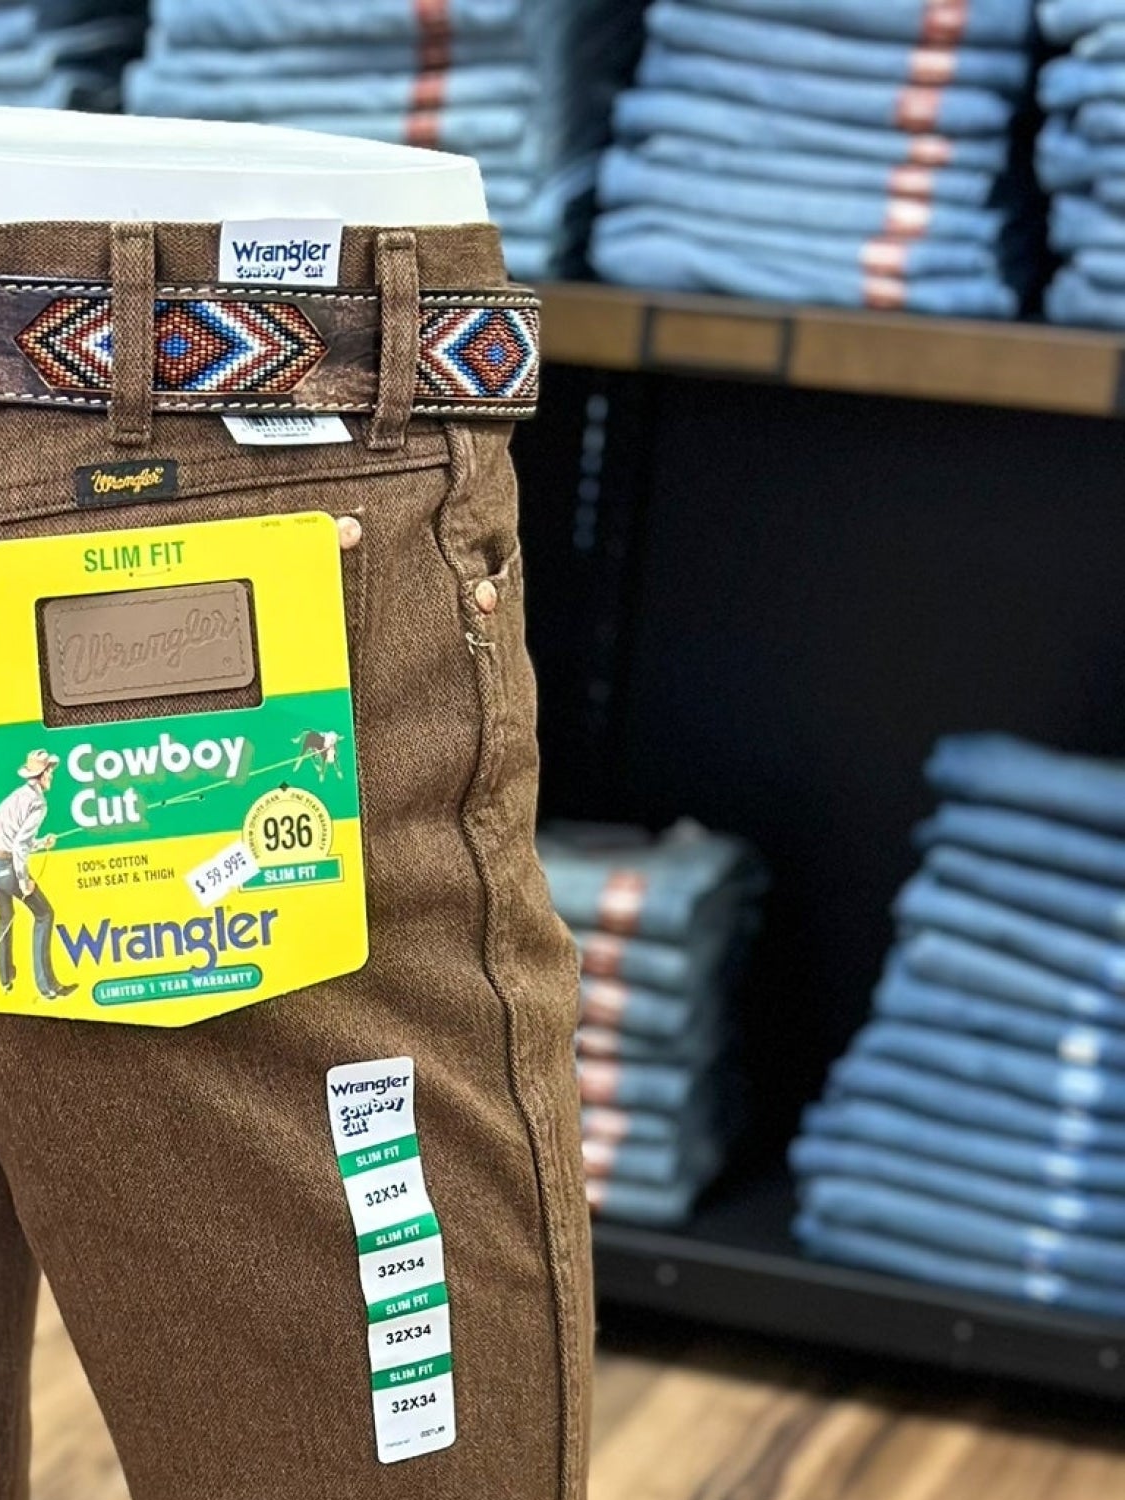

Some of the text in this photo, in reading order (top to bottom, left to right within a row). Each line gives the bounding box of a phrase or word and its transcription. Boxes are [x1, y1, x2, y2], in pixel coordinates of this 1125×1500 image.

[232, 240, 332, 271] Wrangler
[91, 466, 164, 494] Wrangler
[84, 541, 186, 573] SLIM FIT
[63, 608, 238, 685] Wrangler
[67, 733, 246, 783] Cowboy
[71, 787, 141, 827] Cut
[263, 813, 313, 852] 936
[76, 854, 149, 873] 100% COTTON
[264, 865, 317, 883] SLIM FIT
[77, 867, 175, 889] SLIM SEAT & THIGH
[56, 906, 278, 976] Wrangler
[100, 971, 253, 999] LIMITED 1 YEAR WARRANTY
[330, 1075, 410, 1097] Wrangler
[339, 1097, 405, 1121] Cowboy
[355, 1145, 400, 1167] SLIM FIT
[364, 1181, 408, 1207] 32X34
[376, 1224, 421, 1246] SLIM FIT
[377, 1256, 425, 1278] 32X34
[385, 1292, 429, 1316] SLIM FIT
[386, 1324, 432, 1346] 32X34
[389, 1362, 434, 1383] SLIM FIT
[391, 1392, 437, 1414] 32X34
